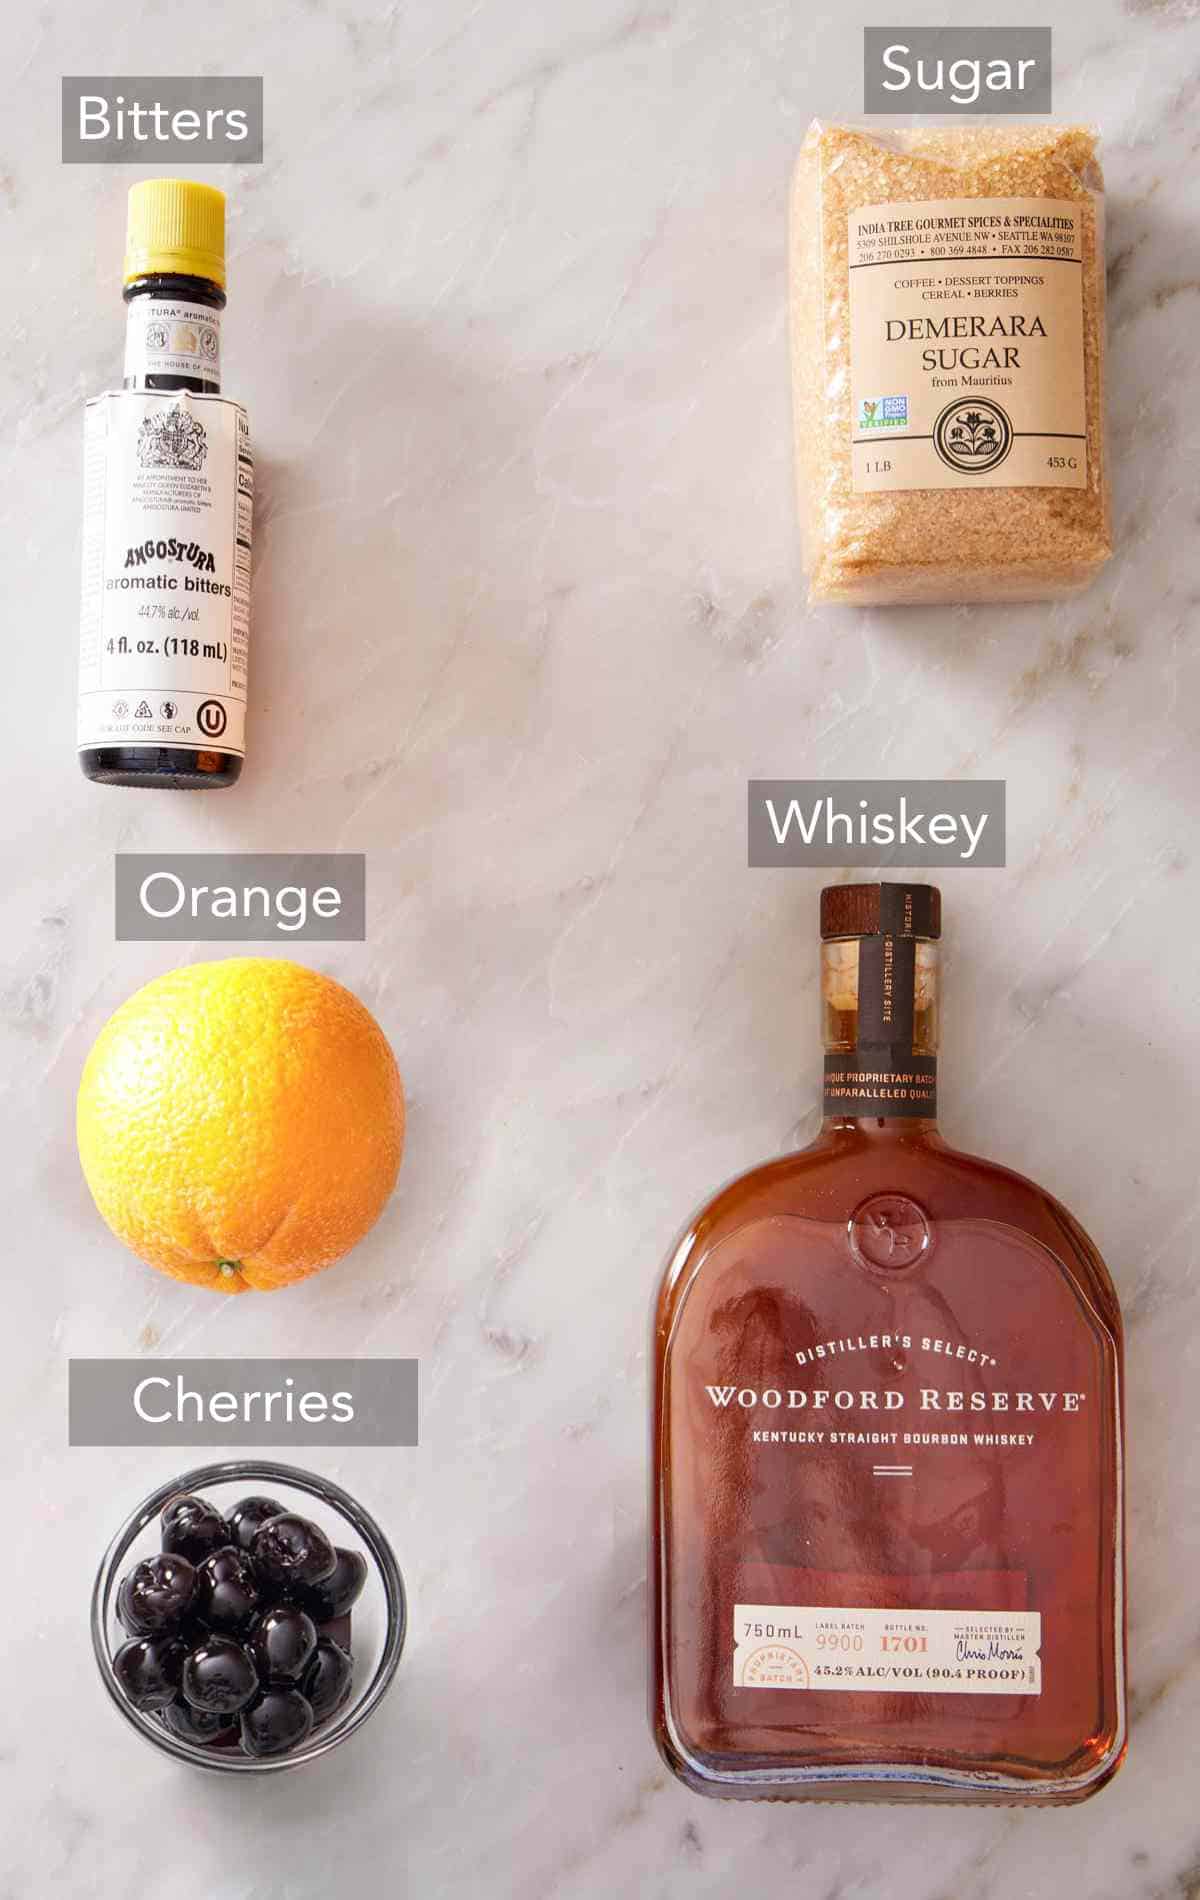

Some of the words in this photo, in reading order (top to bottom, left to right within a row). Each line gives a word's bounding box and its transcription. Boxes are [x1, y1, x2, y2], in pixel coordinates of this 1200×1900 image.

[858, 223, 885, 237] INDIA
[887, 220, 913, 233] TREE
[916, 217, 966, 230] GOURMET
[968, 216, 1001, 228] SPICES
[1003, 215, 1011, 227] &
[1013, 216, 1074, 230] SPECIALITIES
[878, 234, 931, 247] SHILSHOLE
[933, 232, 972, 243] AVENUE
[974, 232, 990, 241] NW
[998, 232, 1038, 241] SEATTLE
[1040, 232, 1053, 242] WA
[894, 248, 915, 258] 0293
[930, 246, 946, 256] 800
[948, 246, 964, 256] 369
[967, 245, 988, 254] 4848
[1002, 244, 1020, 254] FAX
[1024, 244, 1039, 254] 206
[1041, 245, 1055, 255] 282
[894, 278, 936, 289] COFFEE
[945, 276, 992, 286] DESSERT
[995, 275, 1044, 285] TOPPINGS
[922, 290, 965, 300] CEREAL
[974, 289, 1019, 298] BERRIES
[885, 315, 1047, 342] DEMERARA
[922, 347, 1021, 371] SUGAR
[931, 375, 958, 388] from
[961, 374, 1013, 387] Mauritius
[866, 463, 871, 473] 1
[875, 460, 892, 472] LB
[1046, 457, 1065, 469] 453
[1067, 458, 1078, 469] G
[124, 537, 216, 573] ANGOSTURA
[106, 574, 178, 590] aromatic
[184, 575, 232, 598] bitters
[106, 638, 114, 655] 4
[118, 636, 132, 654] fl.
[137, 640, 159, 654] oz.
[164, 637, 199, 657] (118
[203, 641, 227, 664] mL)
[846, 1072, 913, 1083] PROPRIETARY
[830, 1087, 907, 1098] UNPARALLELED
[795, 1335, 912, 1366] DISTILLER'S
[704, 1385, 905, 1410] WOODFORD
[753, 1431, 824, 1444] KENTUCKY
[829, 1431, 898, 1445] STRAIGHT
[903, 1432, 968, 1445] BOURBON
[974, 1433, 1034, 1446] WHISKEY
[744, 1623, 803, 1639] 750mL
[954, 1633, 983, 1641] MASTER
[986, 1633, 1025, 1641] DISTILLER
[816, 1634, 863, 1651] 9900
[880, 1636, 929, 1653] 1701
[956, 1641, 986, 1662] Chris
[814, 1665, 851, 1676] 45.2%
[855, 1667, 922, 1678] ALC/VOL
[926, 1668, 961, 1680] (90.4
[966, 1669, 1025, 1681] PROOF)
